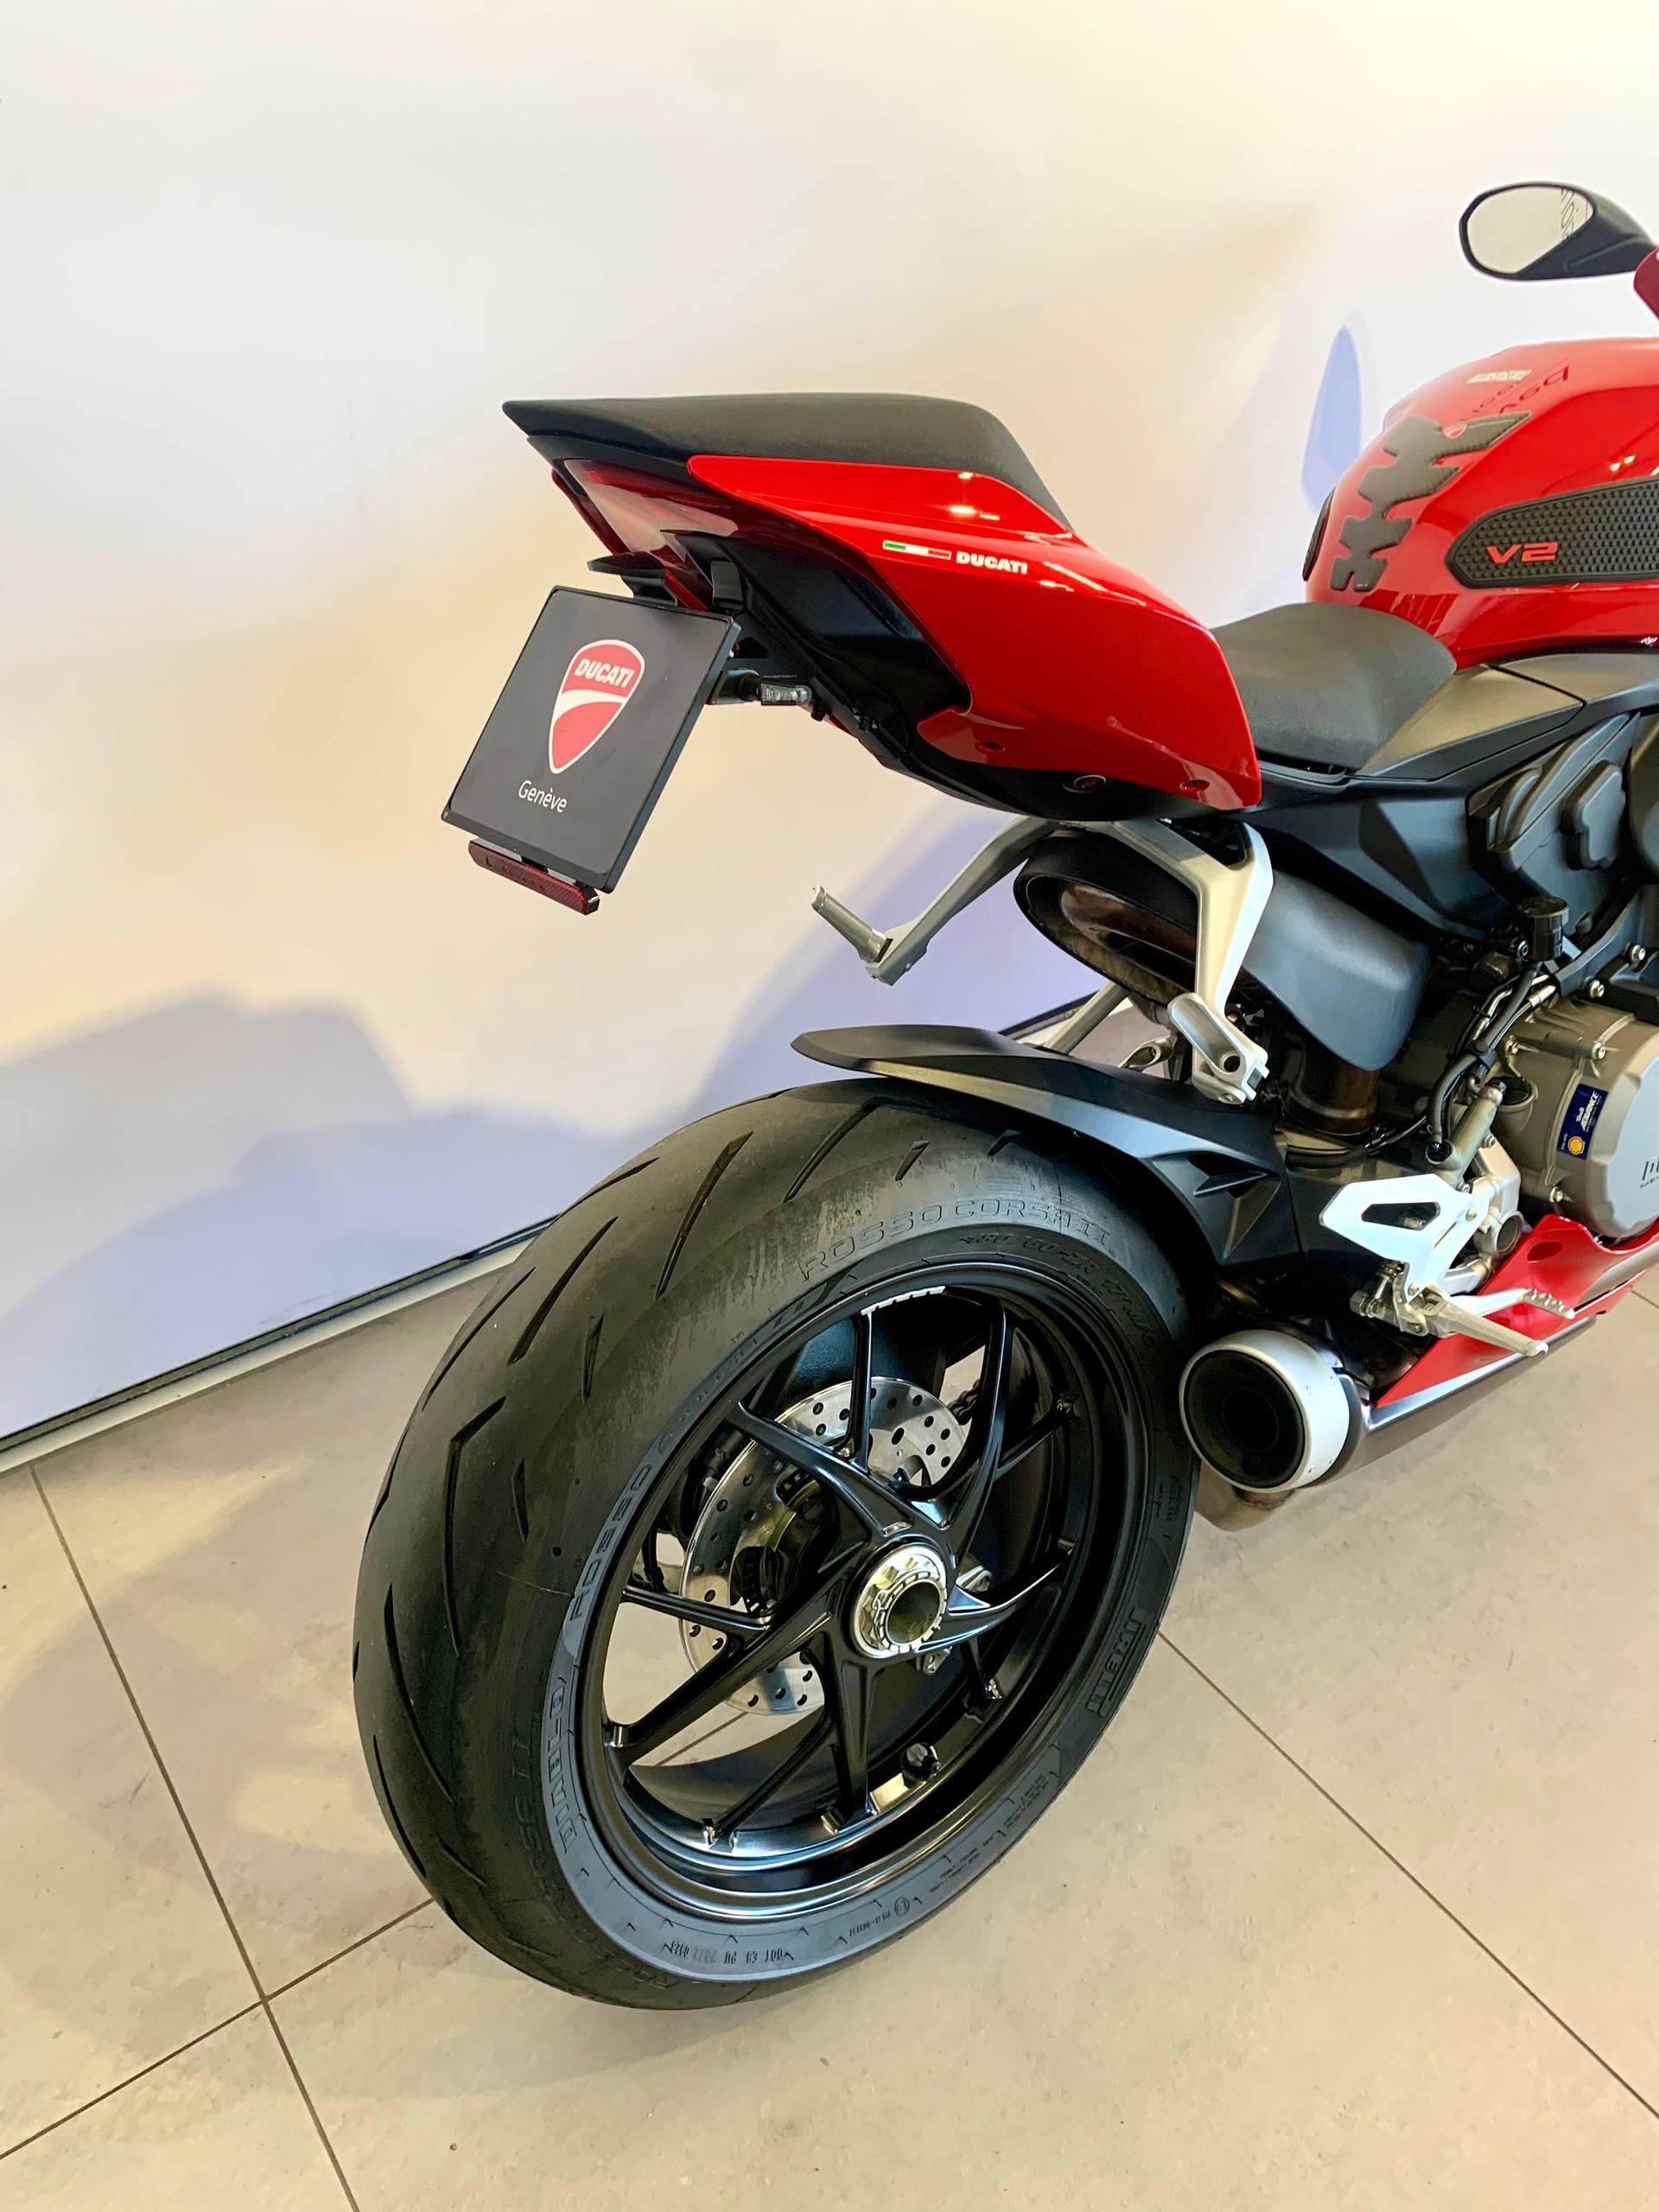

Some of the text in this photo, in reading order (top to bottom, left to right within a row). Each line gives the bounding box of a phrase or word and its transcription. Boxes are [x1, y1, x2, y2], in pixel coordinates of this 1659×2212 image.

[956, 550, 1028, 575] DUCATI
[1486, 542, 1558, 564] V2
[573, 658, 635, 689] DUCATI
[518, 779, 568, 814] Genève
[1580, 1090, 1599, 1132] ADVANCE
[798, 1205, 943, 1283] ROSSO
[954, 1198, 1072, 1229] CORSA
[545, 1685, 578, 1854] DIABLO
